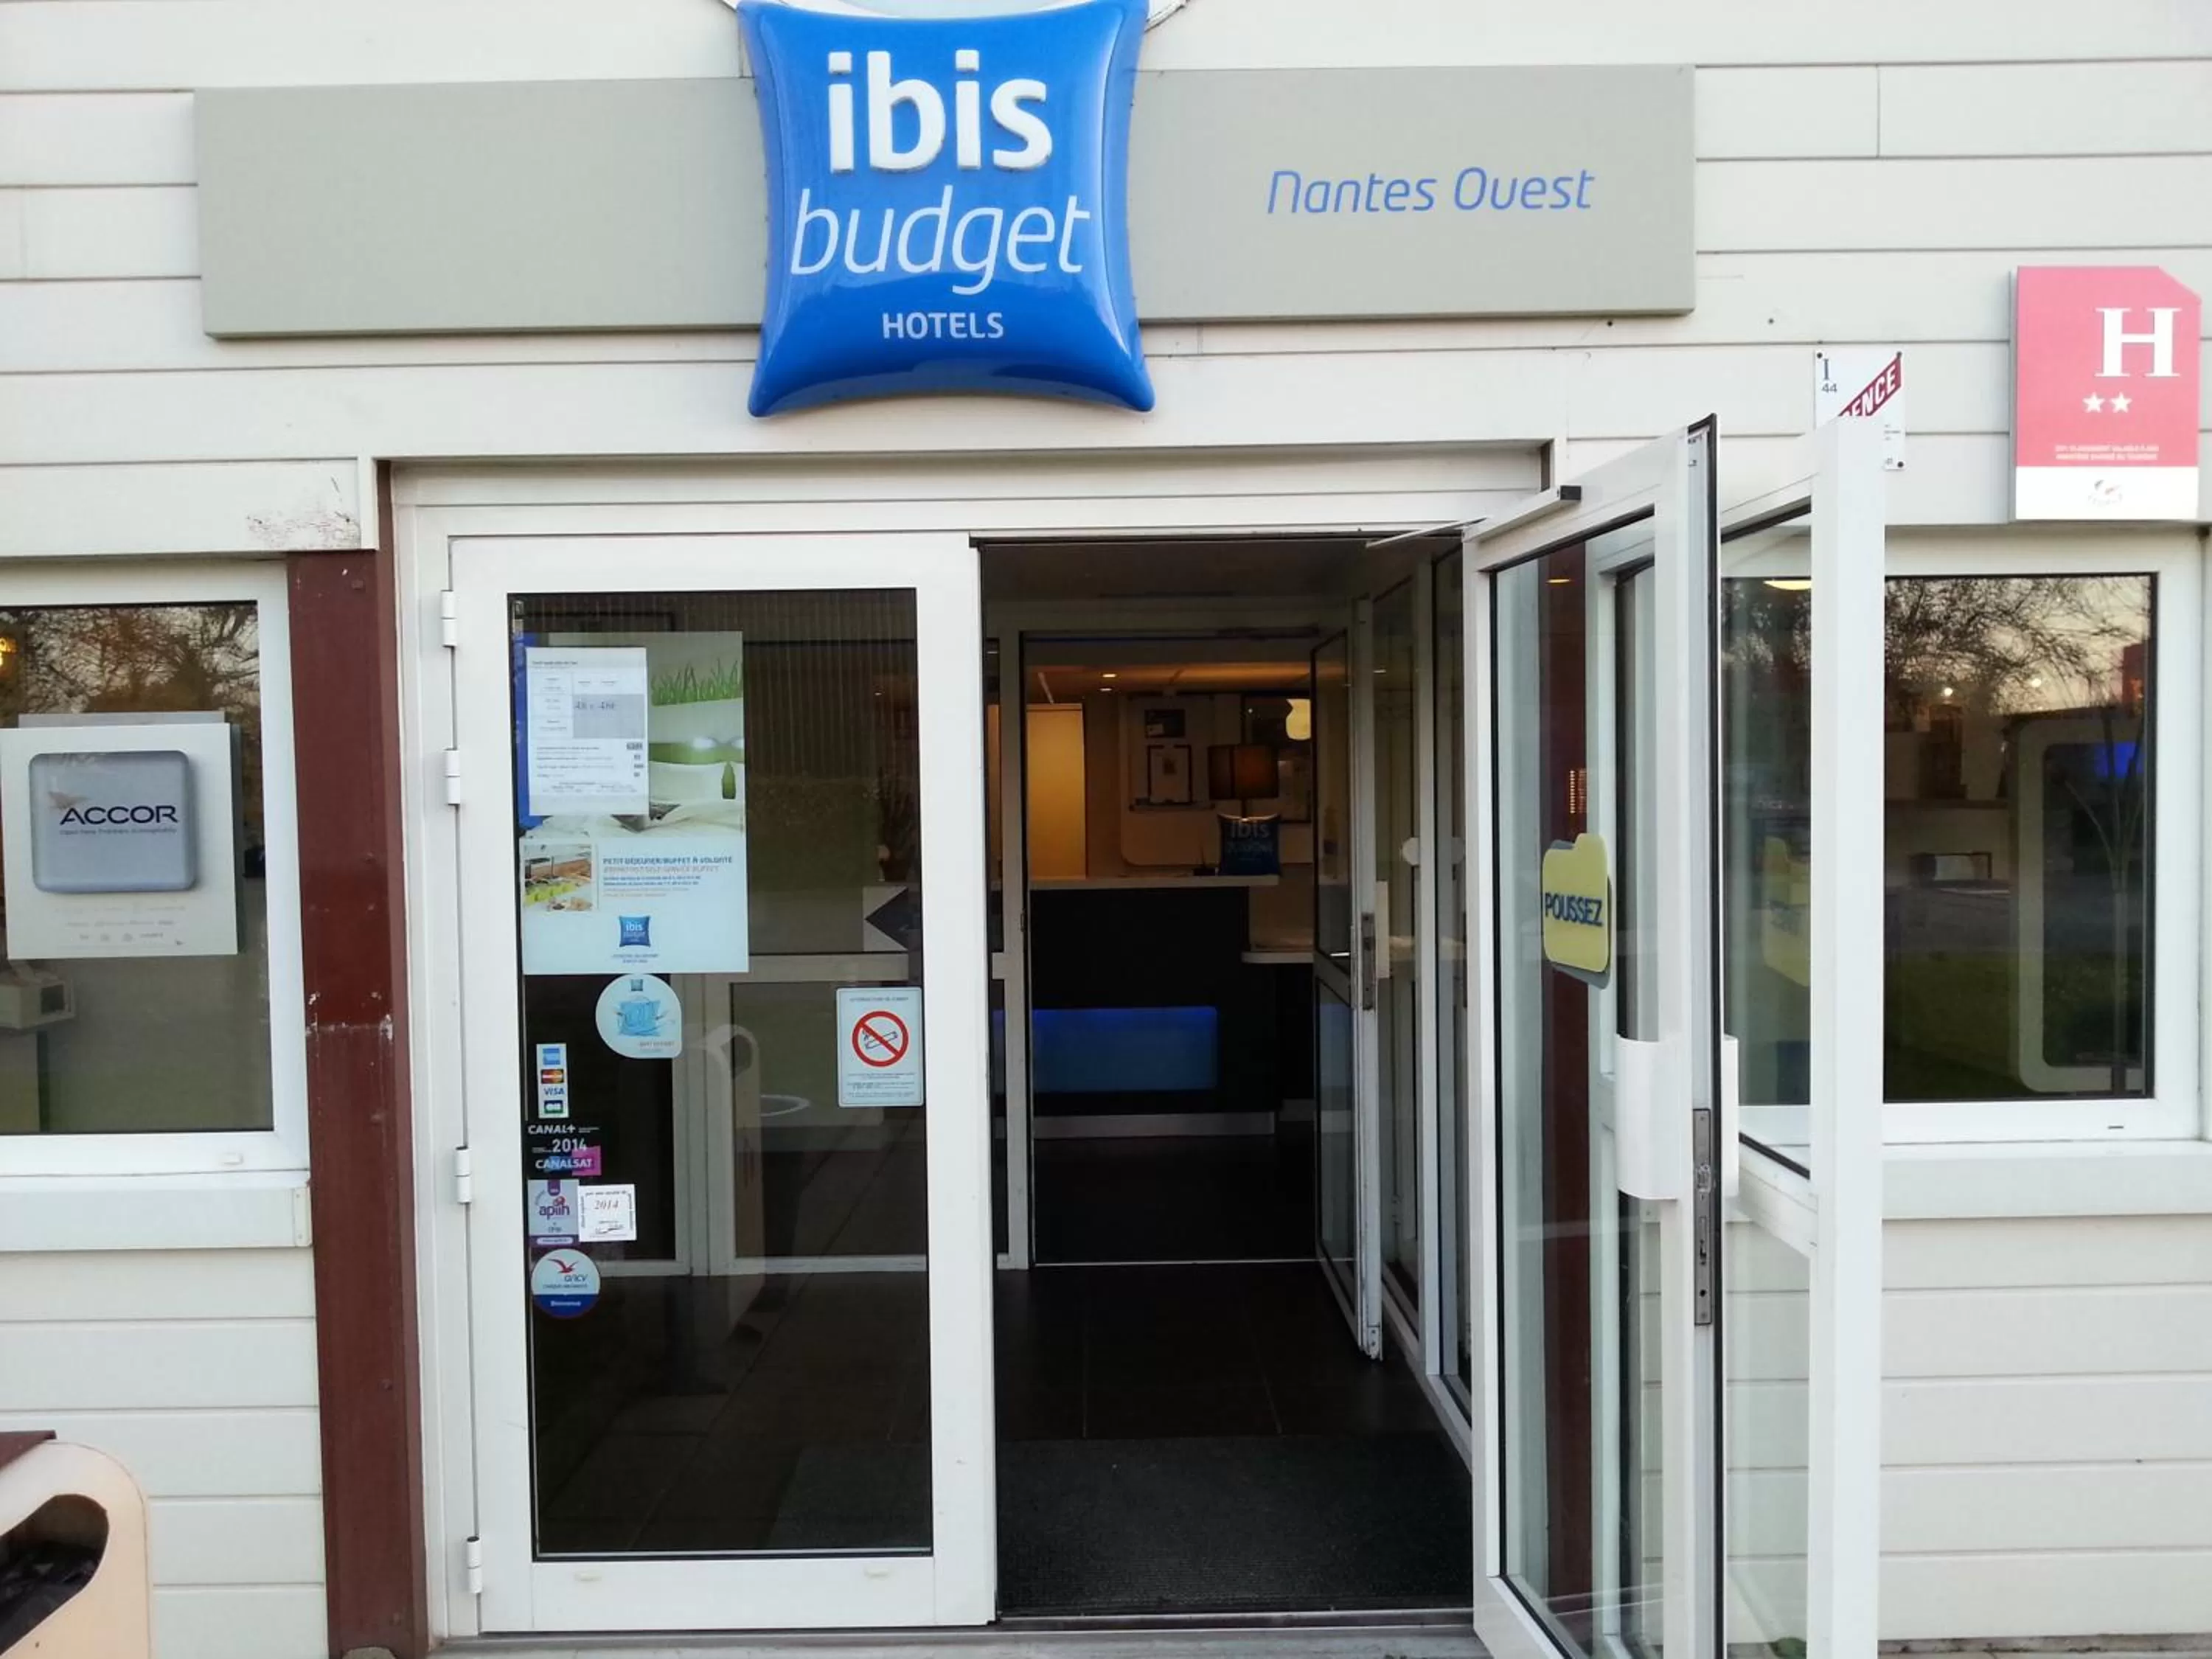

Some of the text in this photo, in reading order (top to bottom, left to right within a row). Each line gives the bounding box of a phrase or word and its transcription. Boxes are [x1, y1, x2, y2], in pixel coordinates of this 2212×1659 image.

[827, 49, 1053, 173] ibis
[1267, 166, 1596, 214] Nantes Ouest
[790, 184, 1091, 296] budget
[883, 311, 1004, 339] HOTELS
[2093, 307, 2183, 378] H
[1821, 382, 1838, 394] 44
[59, 804, 178, 826] ACCOR
[1229, 820, 1270, 838] ibis
[1544, 891, 1604, 928] POUSSEZ
[625, 920, 644, 931] ibis
[543, 1088, 566, 1096] VISA
[527, 1124, 576, 1135] CANAL+
[552, 1138, 588, 1152] 2014
[535, 1158, 594, 1169] CANALSAT
[594, 1200, 619, 1210] 2014
